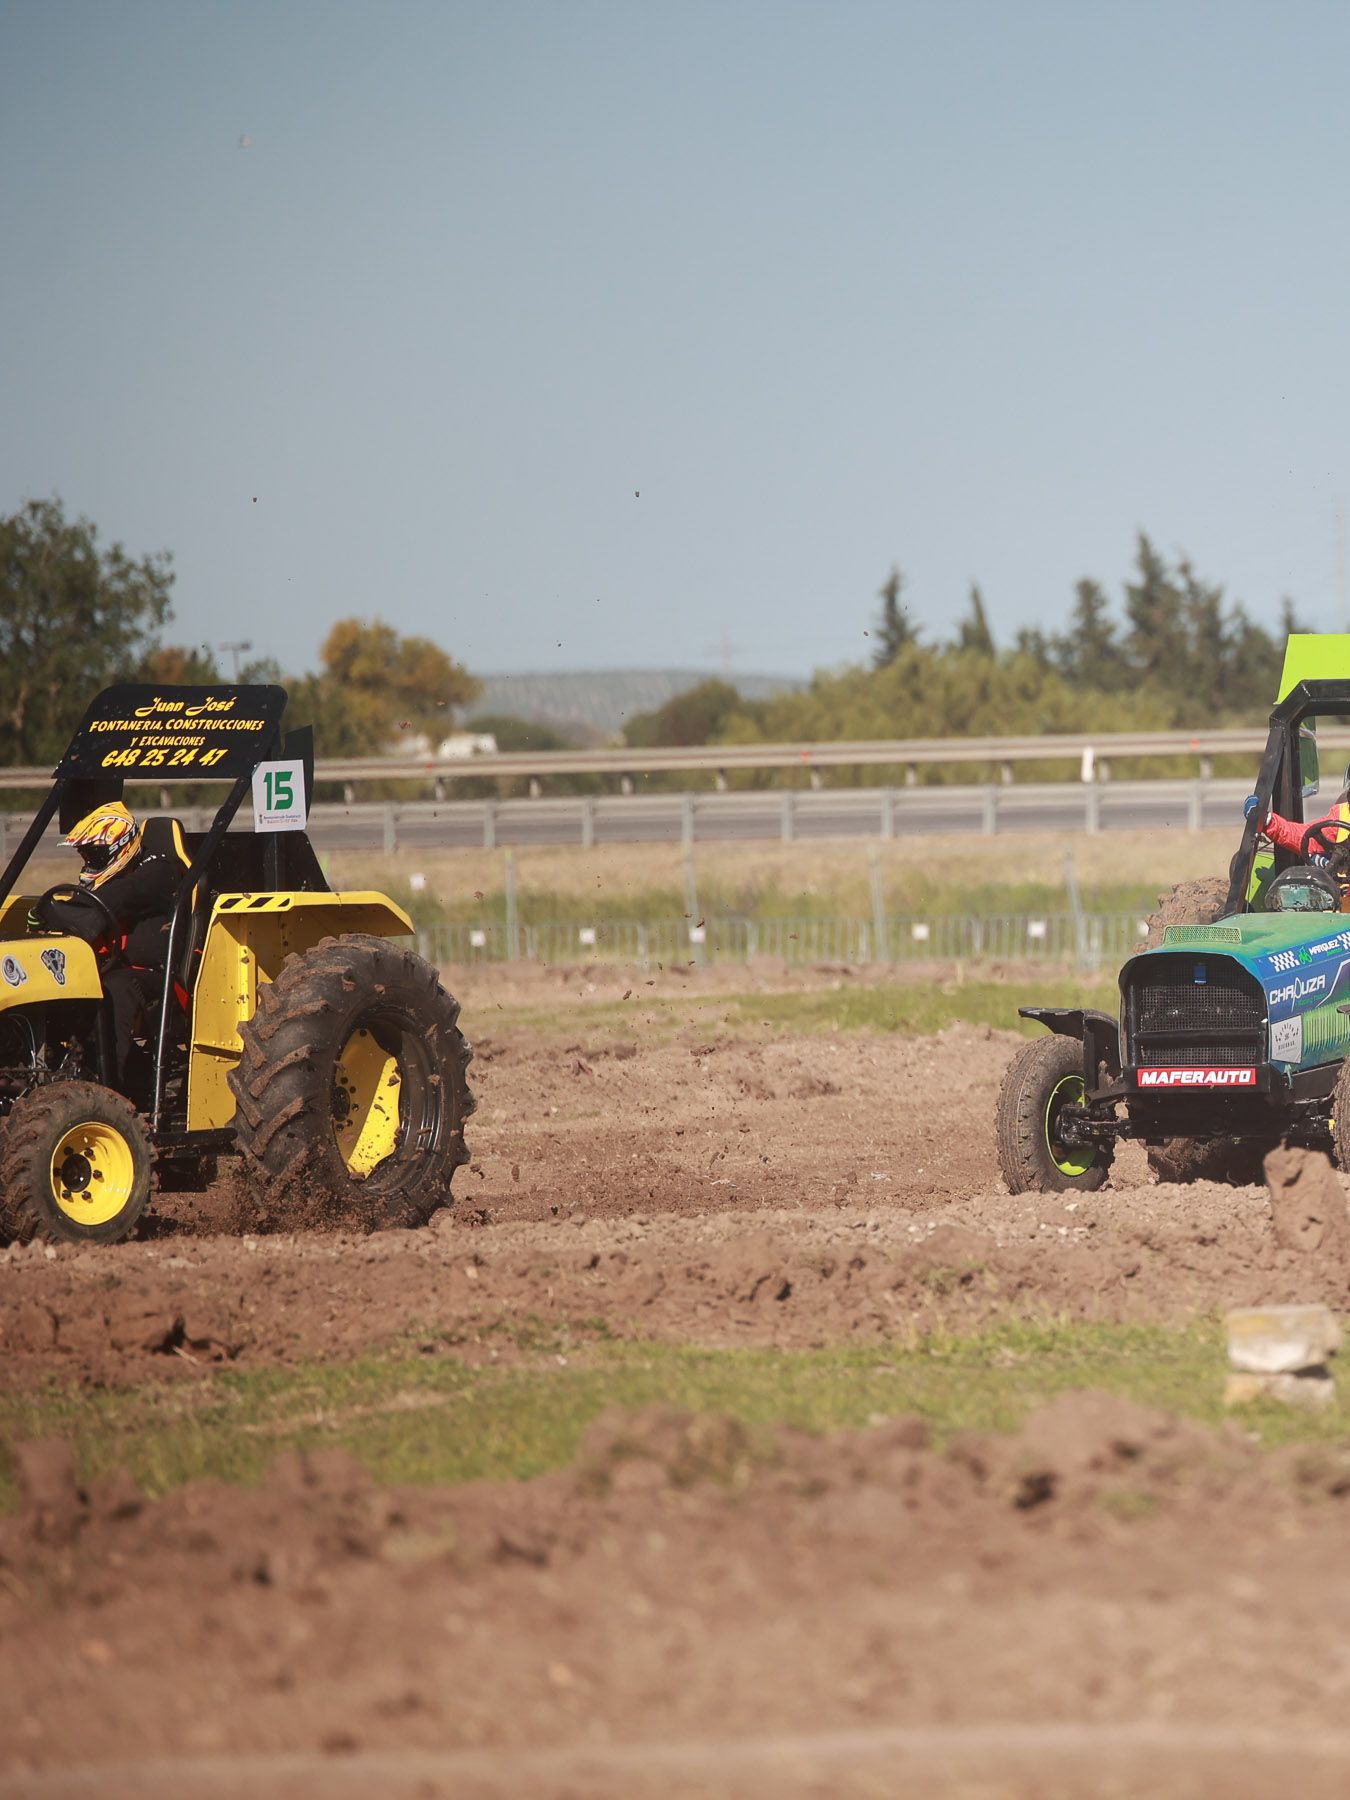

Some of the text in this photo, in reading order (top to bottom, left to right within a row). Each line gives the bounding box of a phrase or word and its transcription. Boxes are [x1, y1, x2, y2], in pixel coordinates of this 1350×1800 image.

[135, 697, 237, 717] Juan José
[165, 719, 265, 731] CONSTRUCCIONES
[138, 736, 206, 747] EXCAVACIONES
[101, 748, 229, 767] 648 25 24 47
[263, 771, 294, 810] 15
[1141, 1070, 1251, 1085] MAFERAUTO
